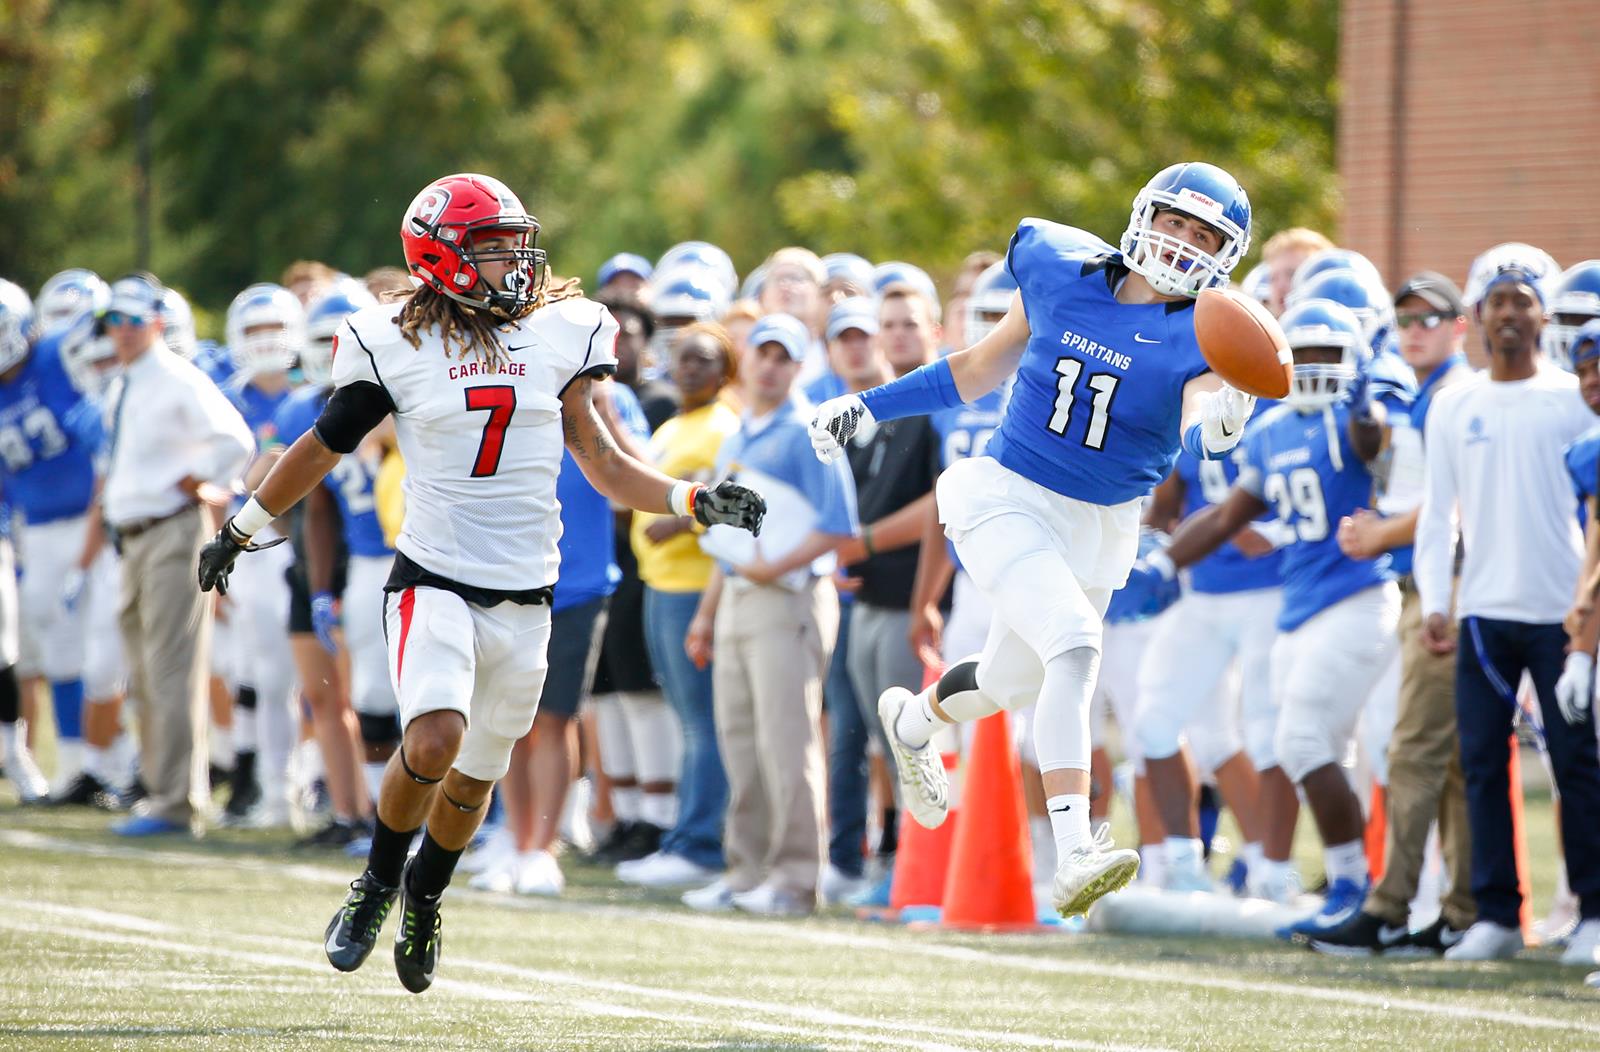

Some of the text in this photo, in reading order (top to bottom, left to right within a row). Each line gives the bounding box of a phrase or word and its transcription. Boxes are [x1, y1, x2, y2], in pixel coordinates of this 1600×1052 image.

[1190, 192, 1214, 207] Riddell
[449, 362, 526, 380] CARTAGE
[1060, 331, 1132, 371] SPARTANS
[1049, 356, 1121, 452] 11
[463, 385, 517, 478] 7
